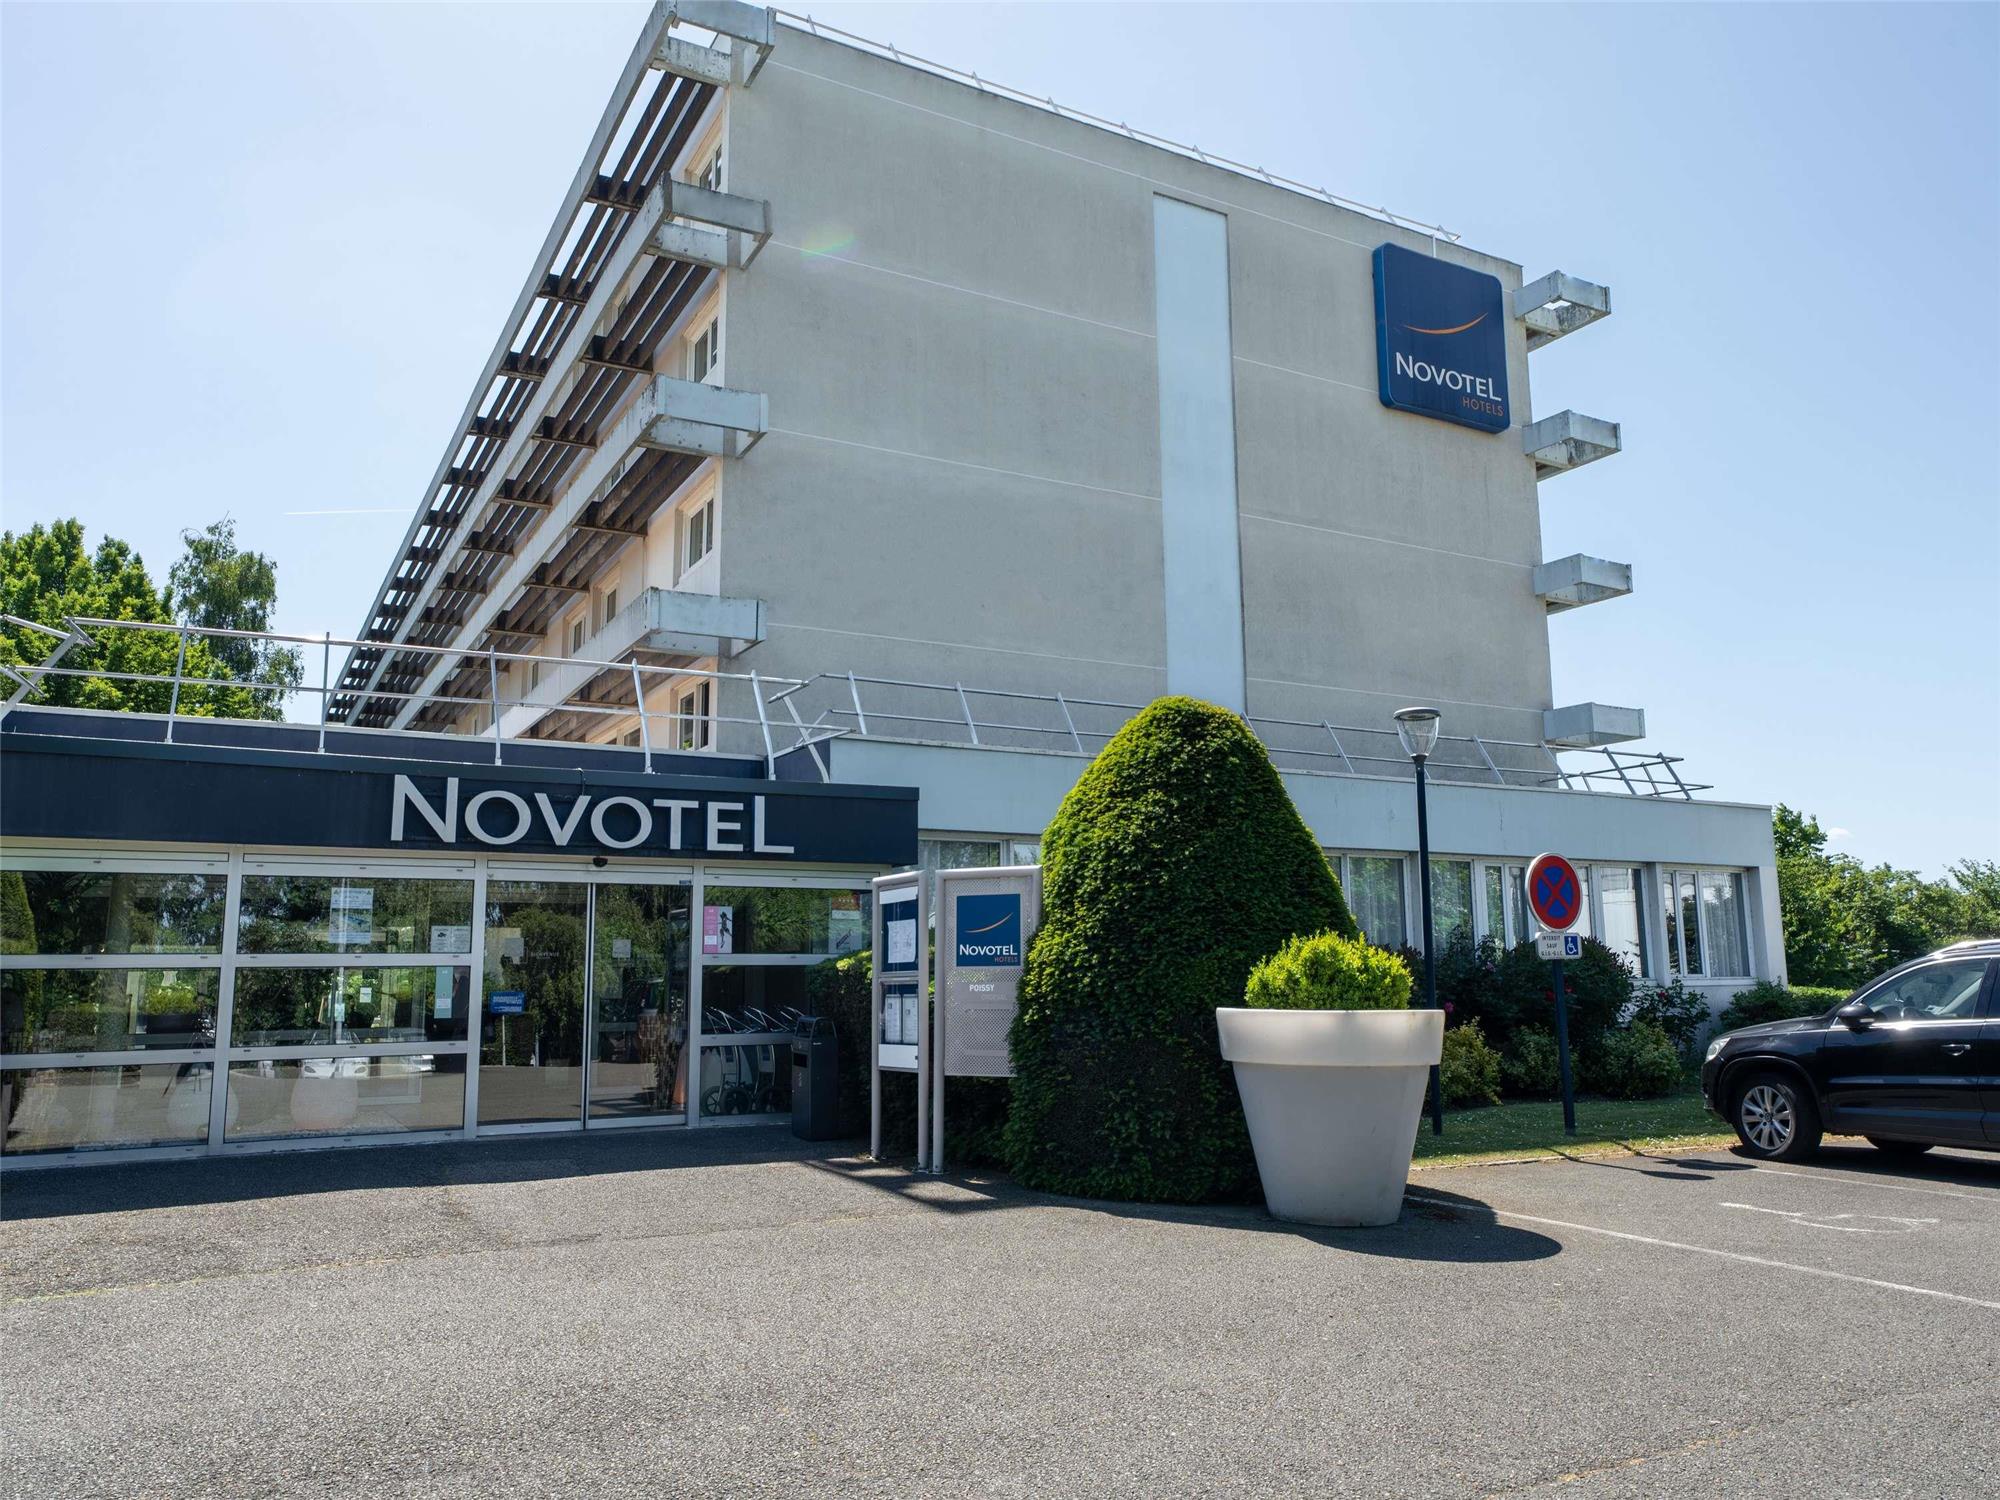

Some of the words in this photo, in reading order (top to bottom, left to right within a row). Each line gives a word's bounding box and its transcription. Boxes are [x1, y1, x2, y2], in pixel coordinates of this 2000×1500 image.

[1396, 352, 1502, 401] NOVOTEL
[1462, 396, 1504, 417] HOTELS
[391, 774, 795, 854] NOVOTEL
[959, 944, 1018, 956] NOVOTEL
[969, 984, 995, 992] POISSY
